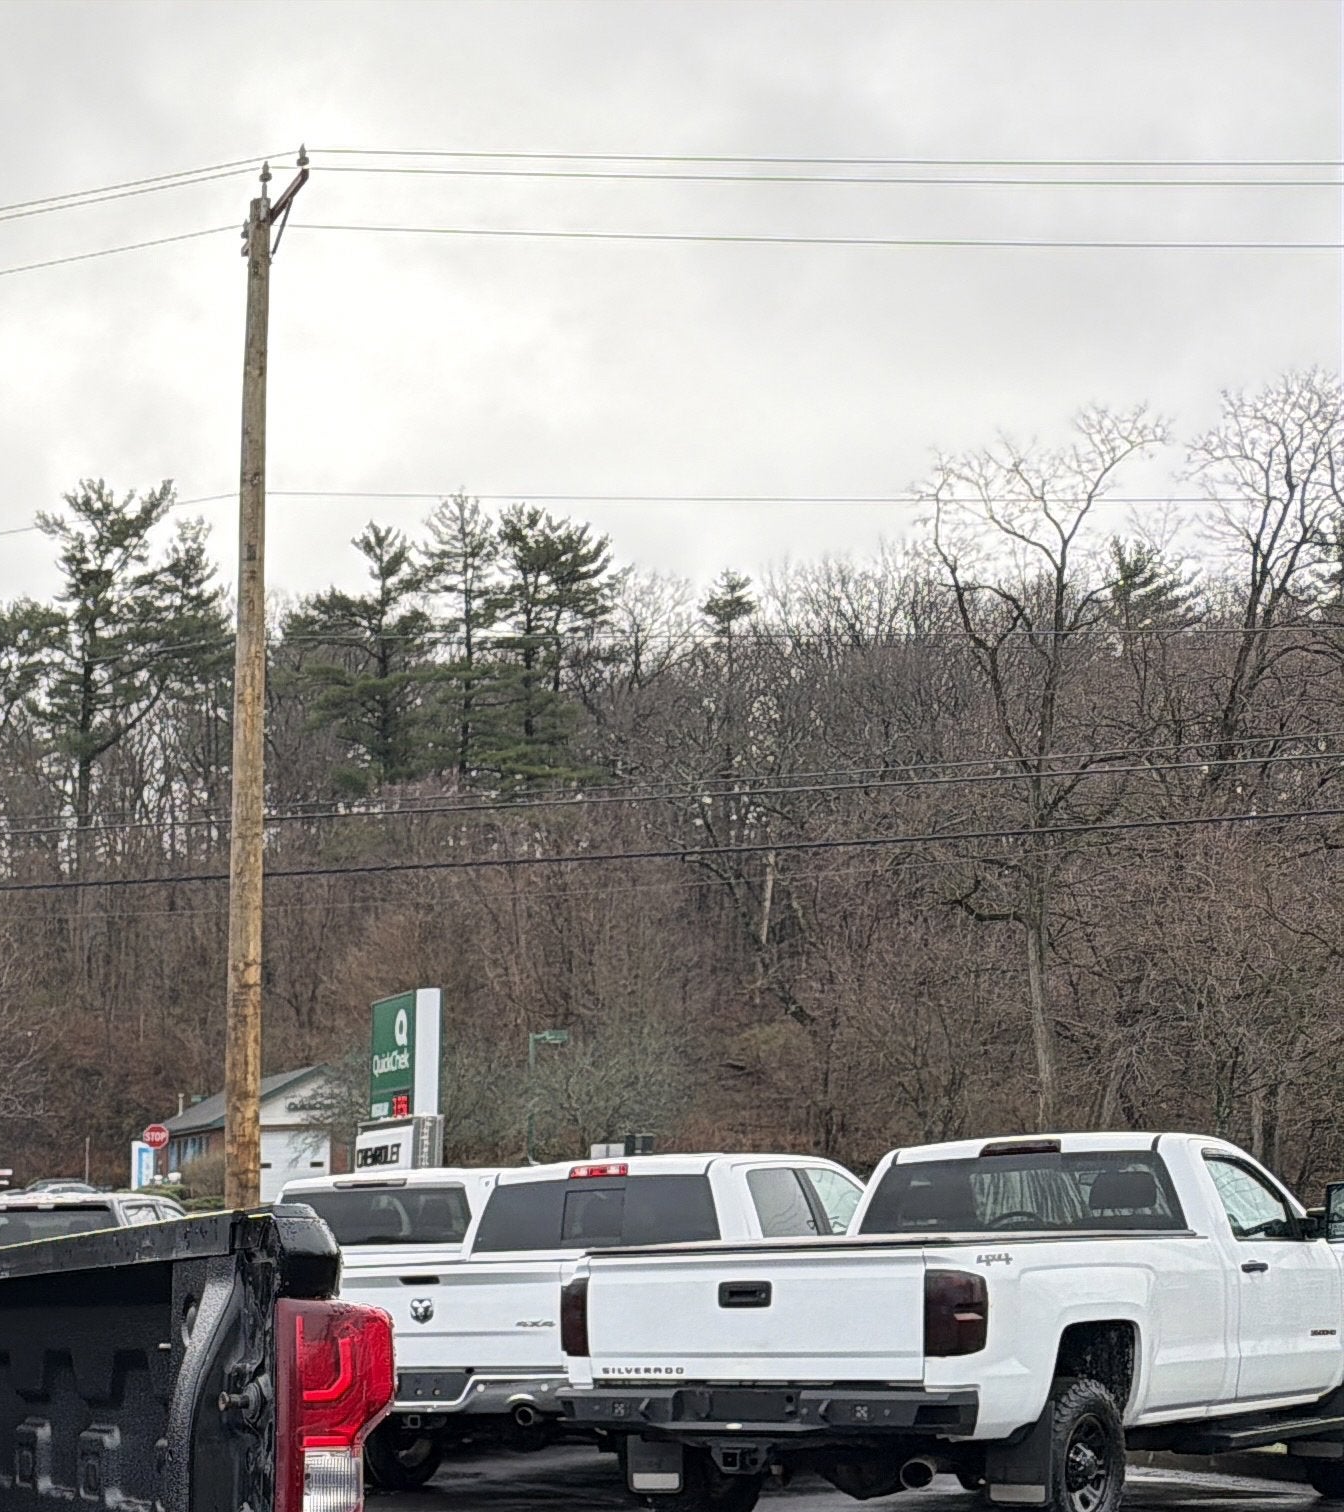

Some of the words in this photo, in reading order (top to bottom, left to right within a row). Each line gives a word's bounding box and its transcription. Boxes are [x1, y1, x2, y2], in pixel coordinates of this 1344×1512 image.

[372, 1048, 409, 1077] QuickChek
[144, 1131, 166, 1142] STOP
[602, 1366, 684, 1375] SILVERADO
